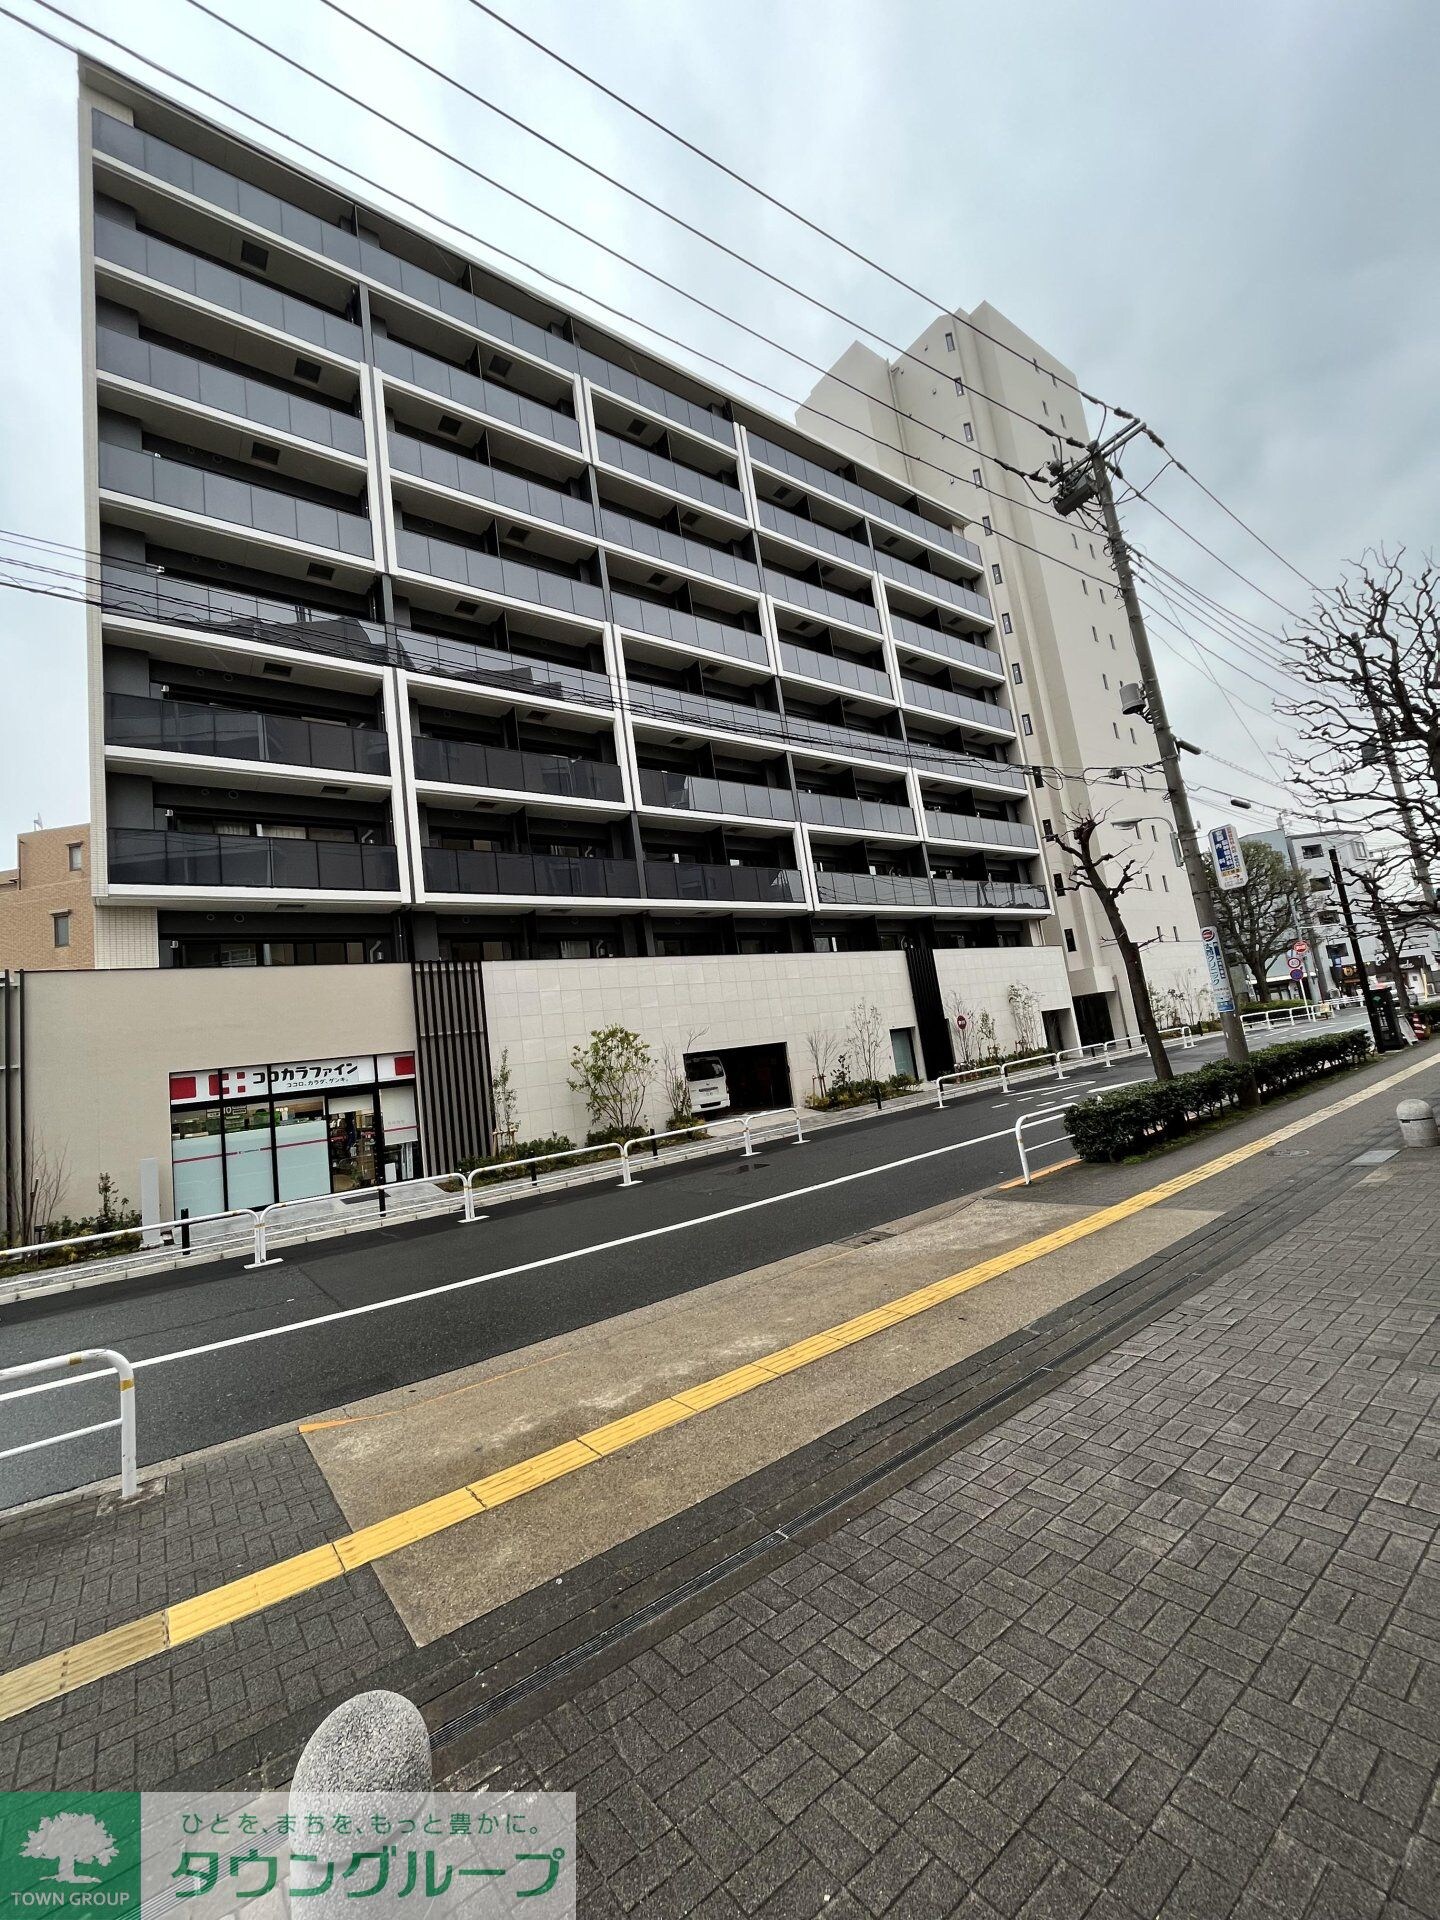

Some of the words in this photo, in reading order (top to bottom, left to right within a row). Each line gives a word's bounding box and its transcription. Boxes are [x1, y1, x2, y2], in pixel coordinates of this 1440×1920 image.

[253, 1063, 358, 1084] ココカラファイン
